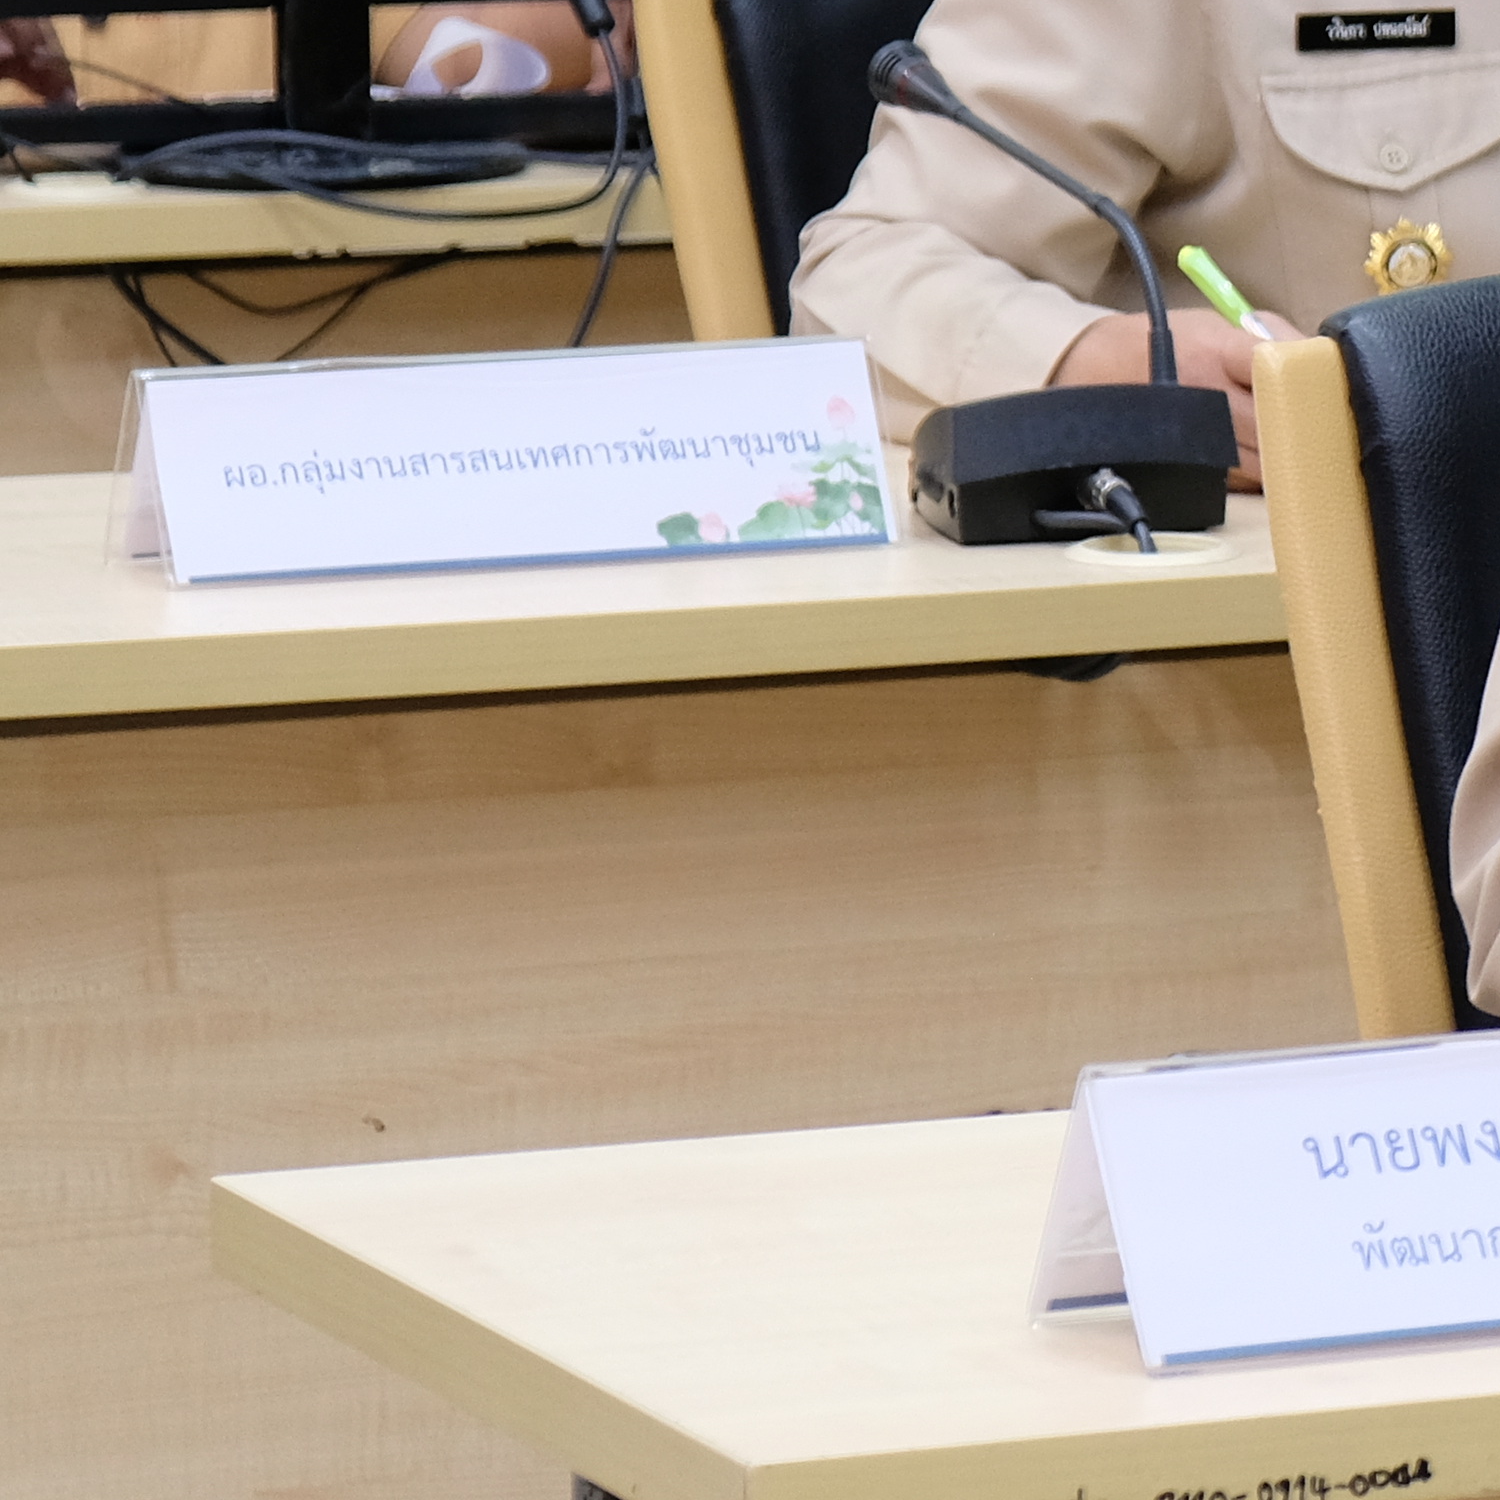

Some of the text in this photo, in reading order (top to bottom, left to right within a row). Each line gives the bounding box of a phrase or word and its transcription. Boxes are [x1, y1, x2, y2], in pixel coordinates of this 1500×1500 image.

[222, 426, 822, 494] ผอ.กลุ่มงานสารสนเทศการพัฒนาชุมชน
